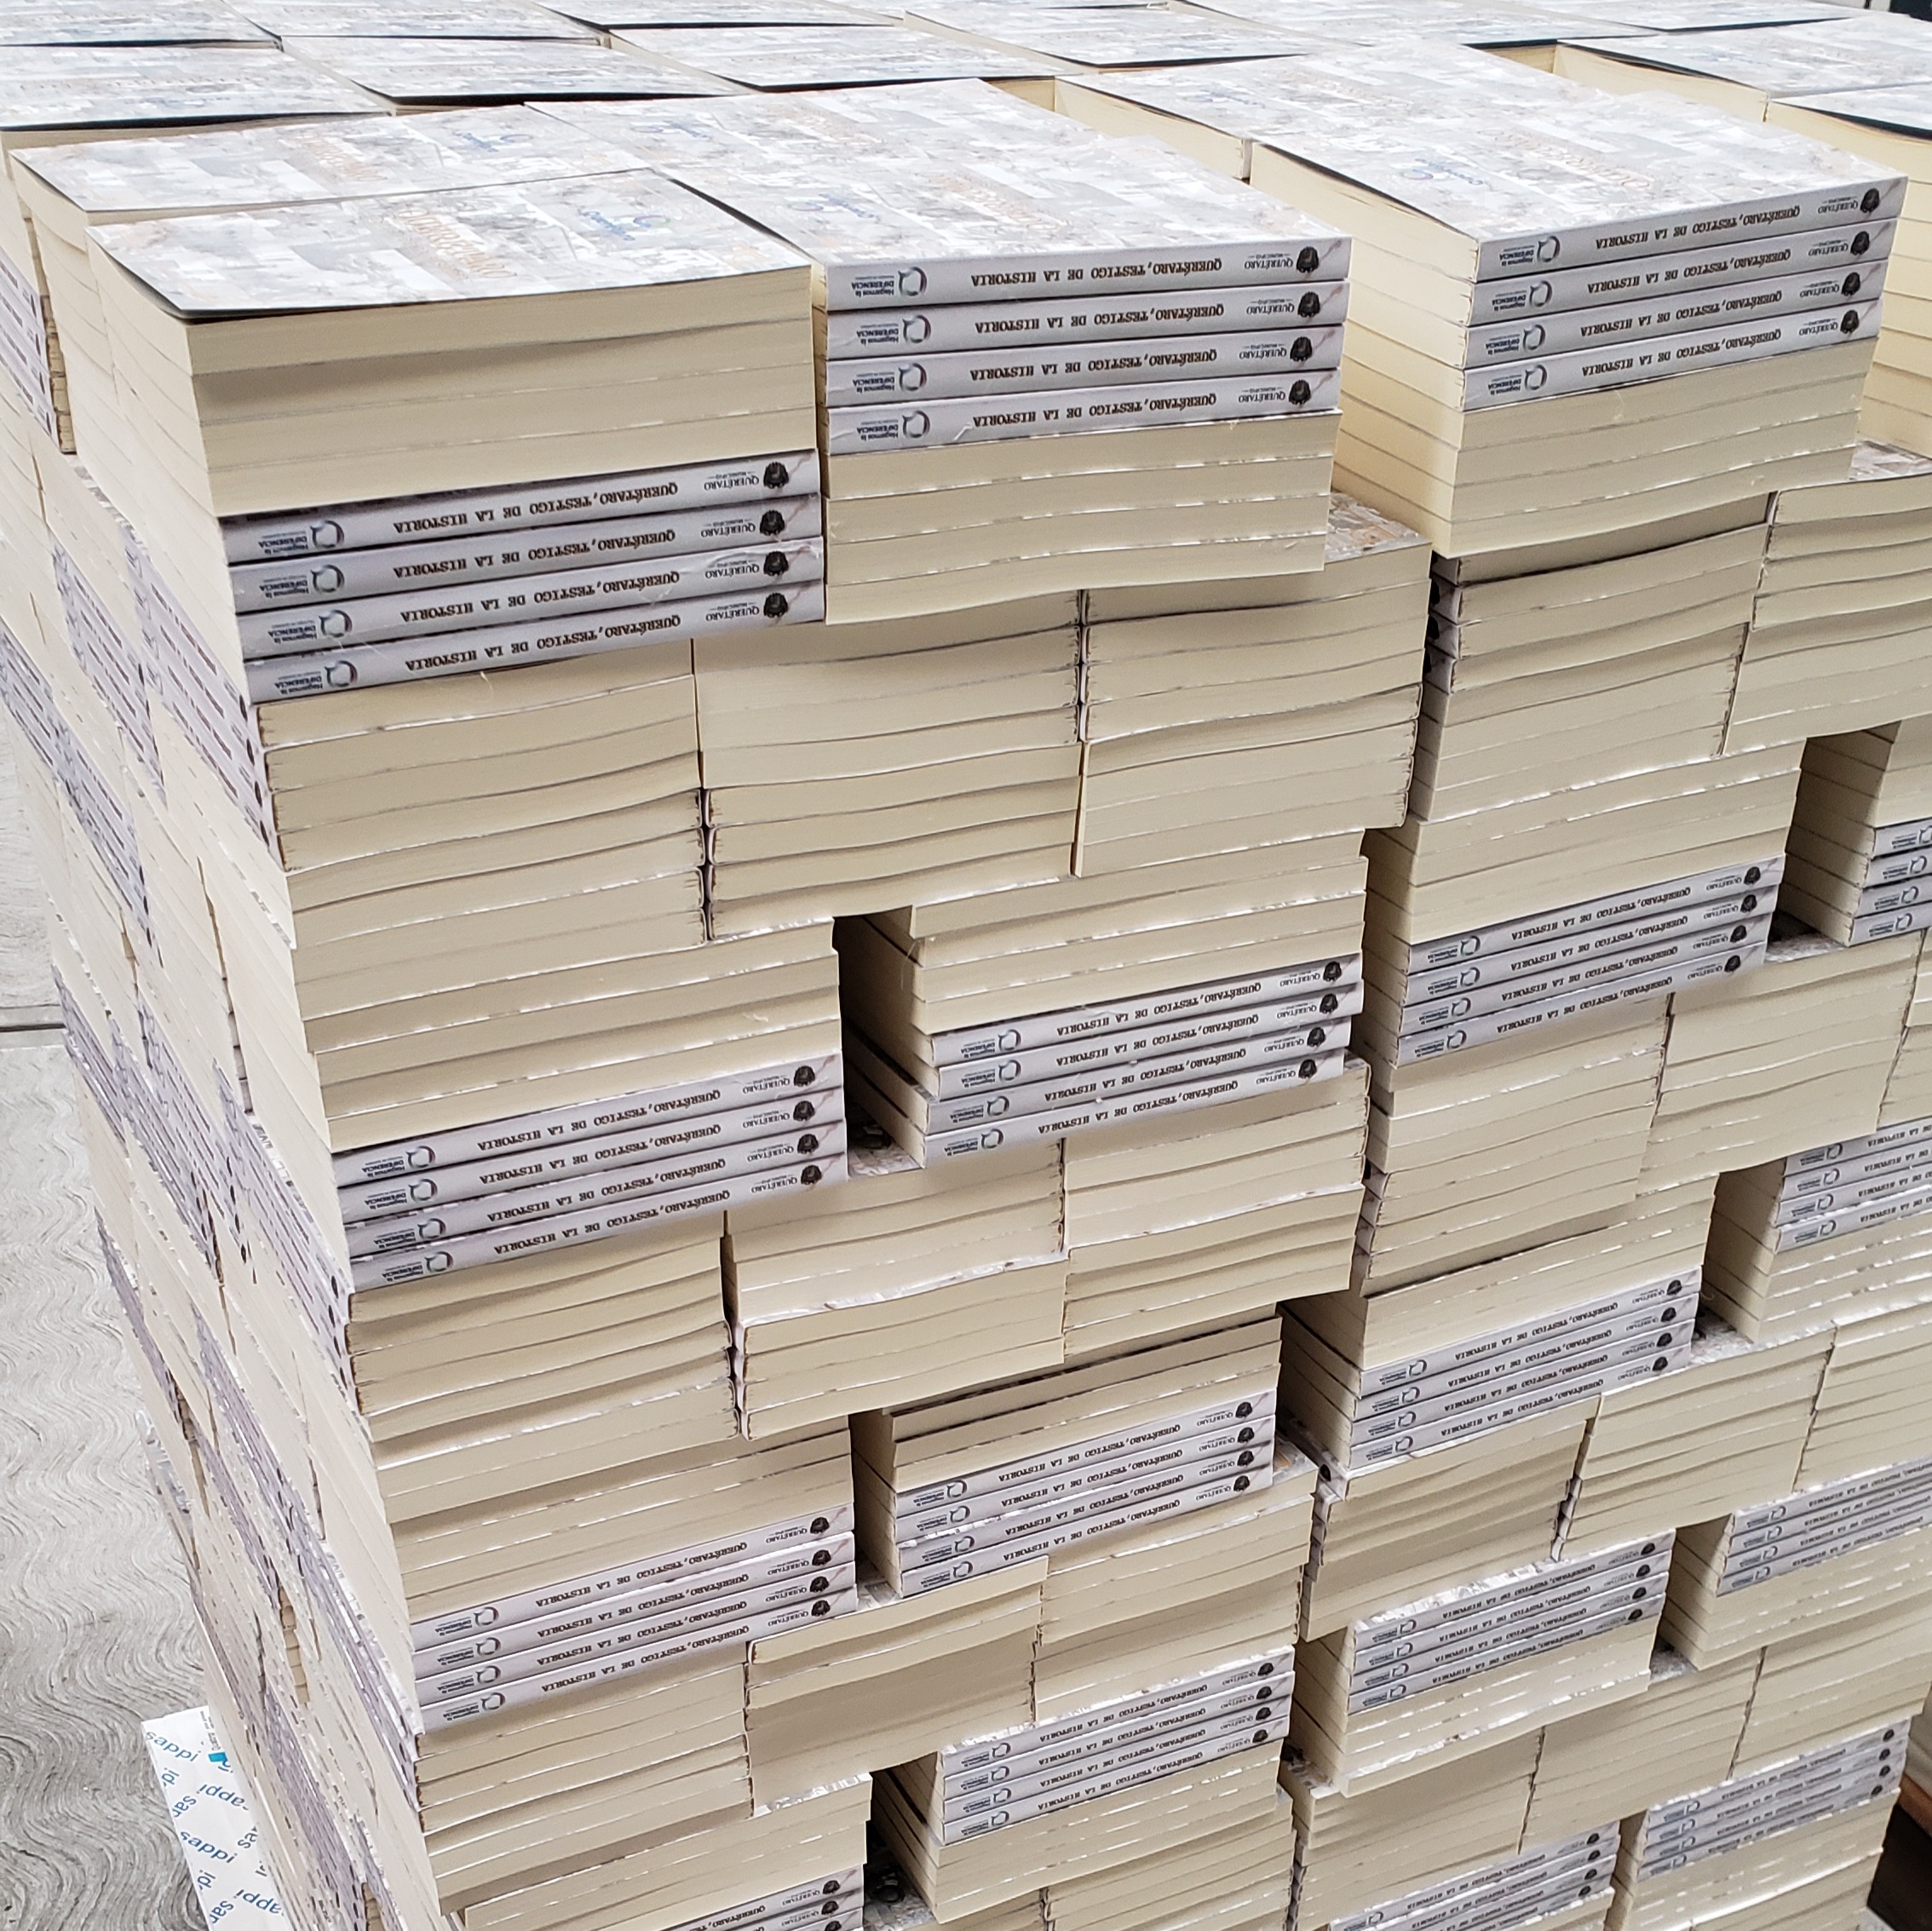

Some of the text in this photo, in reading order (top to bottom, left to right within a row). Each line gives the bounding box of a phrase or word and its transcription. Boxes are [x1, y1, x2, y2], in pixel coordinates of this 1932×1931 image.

[1672, 225, 1688, 237] DE
[1691, 217, 1738, 233] TESTIGO
[1653, 228, 1668, 239] LA
[1595, 232, 1648, 249] HISTORIA
[1067, 268, 1084, 279] DE
[1090, 265, 1146, 279] TESTIGO
[1663, 269, 1679, 280] DE
[1682, 261, 1728, 277] TESTIGO
[970, 272, 1037, 286] HISTORIA
[1043, 270, 1061, 281] LA
[1645, 273, 1659, 284] LA
[851, 280, 894, 289] DIFERENCIA
[1587, 275, 1640, 293] HISTORIA
[1675, 303, 1721, 319] TESTIGO
[1046, 317, 1063, 328] LA
[1070, 315, 1087, 326] DE
[1093, 311, 1149, 325] TESTIGO
[1637, 315, 1652, 326] LA
[1656, 312, 1670, 323] DE
[974, 319, 1039, 333] HISTORIA
[1579, 319, 1633, 336] HISTORIA
[1676, 342, 1721, 358] TESTIGO
[1638, 354, 1653, 365] LA
[1657, 351, 1671, 362] DE
[1040, 364, 1058, 375] LA
[1064, 362, 1081, 372] DE
[1087, 357, 1142, 371] TESTIGO
[1581, 358, 1634, 376] HISTORIA
[969, 365, 1034, 380] HISTORIA
[1042, 409, 1059, 420] LA
[1066, 407, 1082, 417] DE
[1088, 401, 1142, 416] TESTIGO
[972, 411, 1036, 427] HISTORIA
[528, 496, 592, 514] TESTIGO
[474, 509, 494, 521] LA
[502, 506, 521, 518] DE
[392, 513, 468, 533] HISTORIA
[501, 551, 520, 563] DE
[527, 543, 590, 560] TESTIGO
[474, 555, 493, 566] LA
[392, 558, 467, 578] HISTORIA
[259, 580, 308, 591] DIFERENCIA
[532, 585, 595, 602] TESTIGO
[480, 599, 500, 610] LA
[507, 595, 526, 606] DE
[400, 602, 474, 622] HISTORIA
[536, 630, 598, 648] TESTIGO
[483, 646, 503, 657] LA
[510, 641, 529, 653] DE
[404, 650, 477, 670] HISTORIA
[274, 676, 321, 688] DIFERENCIA
[1562, 917, 1575, 927] LA
[1578, 913, 1592, 922] DE
[1153, 997, 1199, 1014] TESTIGO
[1114, 1013, 1129, 1022] LA
[1134, 1009, 1148, 1019] DE
[1055, 1017, 1109, 1035] HISTORIA
[1152, 1029, 1197, 1045] TESTIGO
[1113, 1043, 1127, 1053] LA
[1133, 1039, 1147, 1049] DE
[1055, 1048, 1108, 1066] HISTORIA
[1132, 1095, 1177, 1112] TESTIGO
[592, 1107, 647, 1125] TESTIGO
[1095, 1111, 1108, 1120] LA
[1113, 1106, 1127, 1116] DE
[546, 1125, 564, 1135] LA
[570, 1120, 587, 1130] DE
[1038, 1115, 1090, 1133] HISTORIA
[476, 1130, 541, 1150] HISTORIA
[594, 1141, 648, 1159] TESTIGO
[548, 1159, 566, 1169] LA
[572, 1154, 589, 1164] DE
[479, 1164, 543, 1183] HISTORIA
[606, 1209, 659, 1227] TESTIGO
[561, 1228, 578, 1238] LA
[584, 1222, 601, 1233] DE
[493, 1233, 556, 1254] HISTORIA
[1500, 1336, 1512, 1345] LA
[1052, 1483, 1065, 1491] LA
[1069, 1479, 1082, 1487] DE
[1000, 1488, 1048, 1506] HISTORIA
[635, 1560, 684, 1579] TESTIGO
[595, 1581, 611, 1589] LA
[616, 1575, 631, 1584] DE
[535, 1586, 591, 1606] HISTORIA
[637, 1592, 685, 1609] TESTIGO
[597, 1612, 612, 1620] LA
[618, 1606, 632, 1615] DE
[537, 1618, 593, 1637] HISTORIA
[147, 1731, 201, 1762] sappi
[196, 1784, 249, 1811] appi
[180, 1831, 238, 1864] sappi
